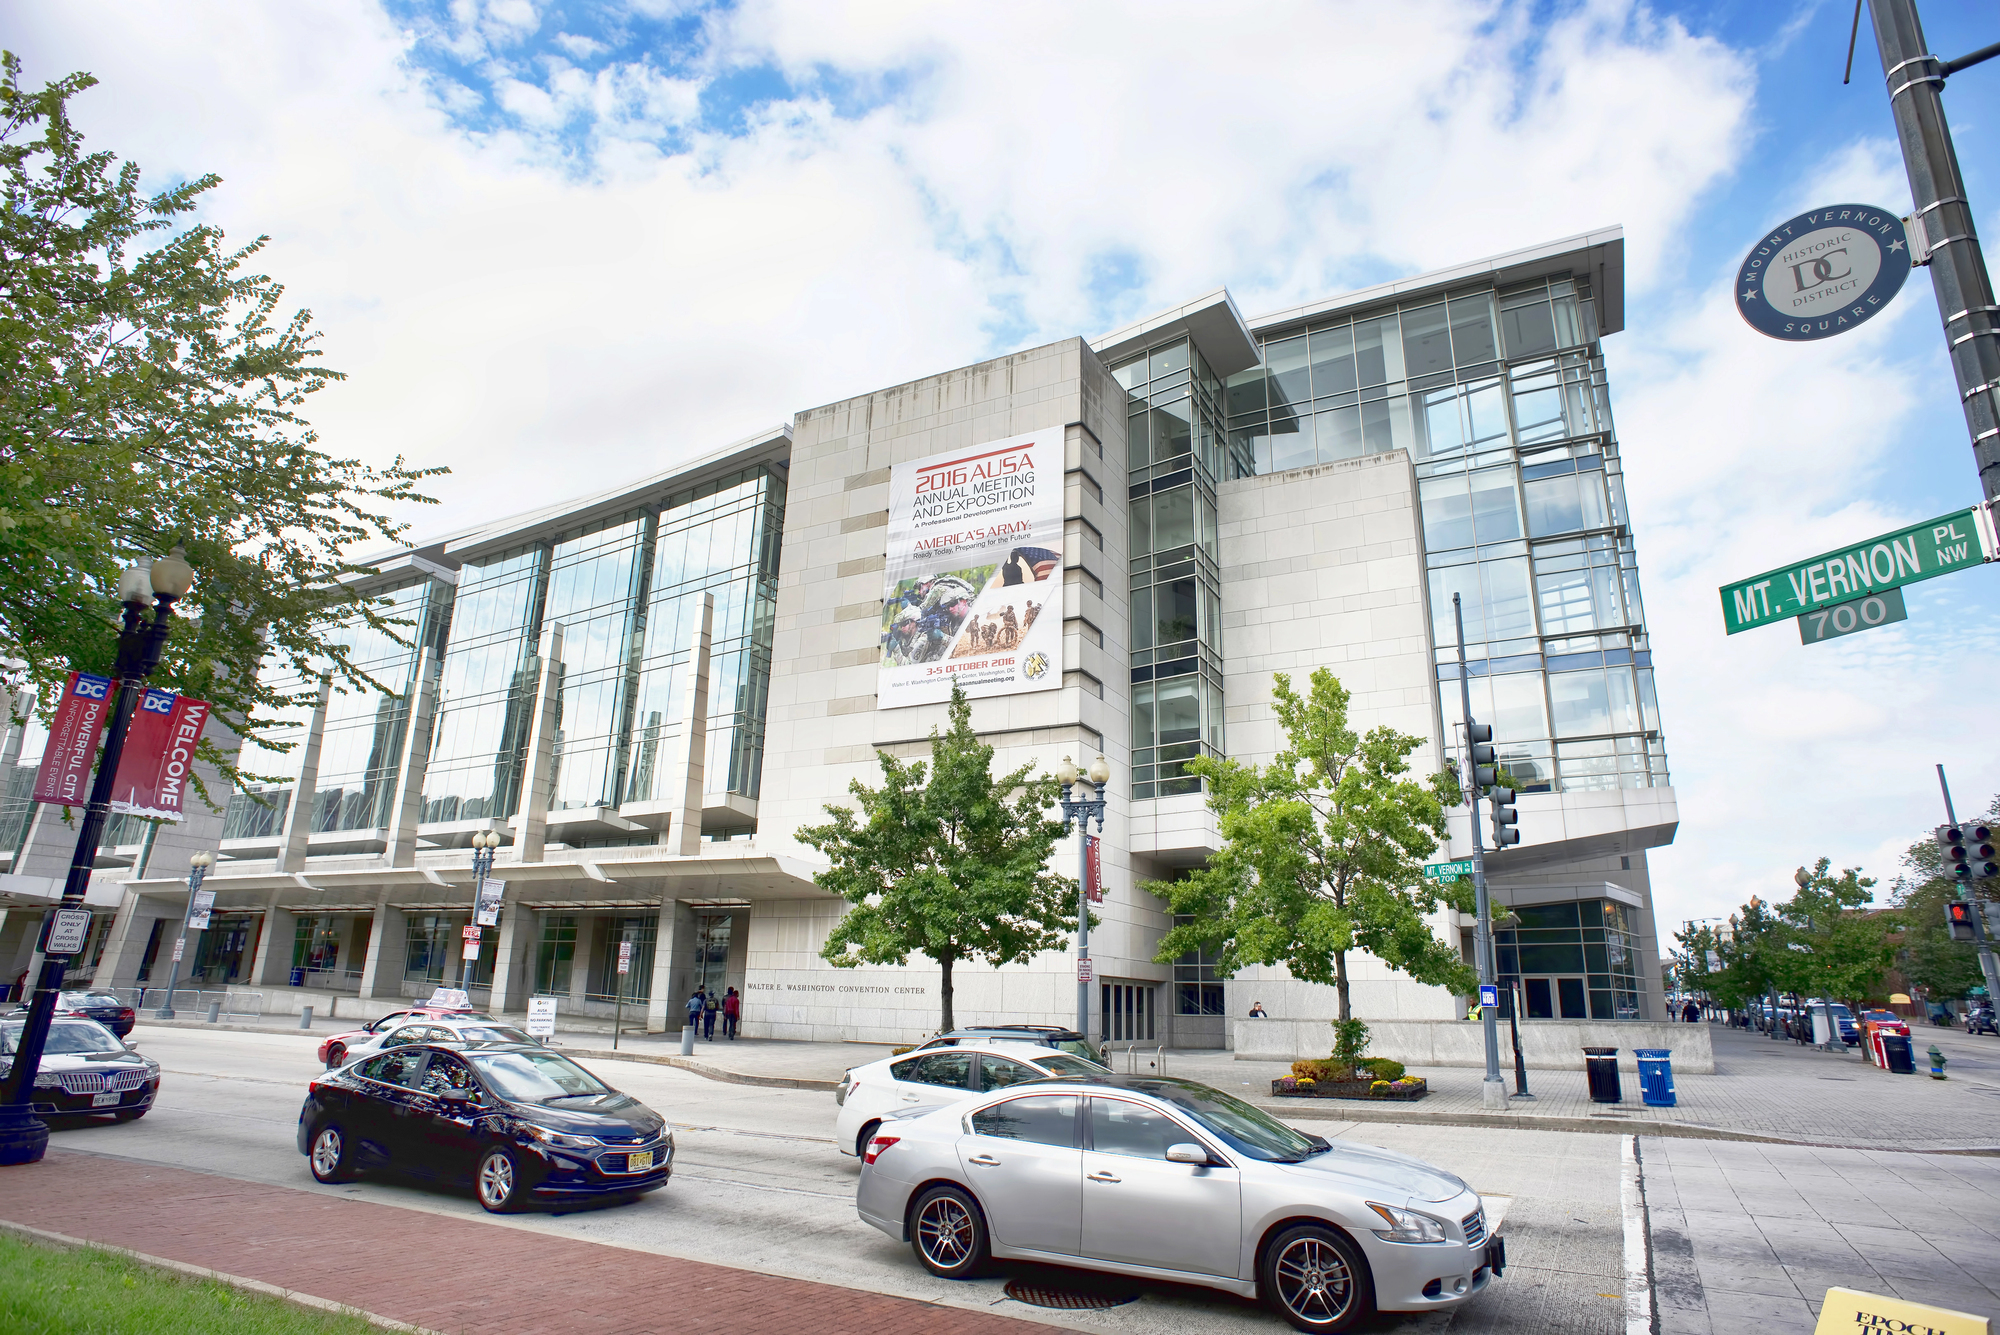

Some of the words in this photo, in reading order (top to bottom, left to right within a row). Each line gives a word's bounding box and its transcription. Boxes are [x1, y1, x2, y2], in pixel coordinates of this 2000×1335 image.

[1745, 226, 1792, 282] MOUNT
[1808, 210, 1893, 235] VERNON
[1783, 232, 1852, 264] HISTORIC
[1788, 247, 1852, 294] DC
[1792, 278, 1859, 307] DISTRICT
[1783, 294, 1881, 335] SQUARE
[912, 486, 969, 508] ANNUAL
[973, 471, 1035, 495] MEETING
[916, 466, 967, 494] 2016
[970, 453, 1035, 482] AUSA
[912, 504, 943, 521] AND
[946, 484, 1035, 514] EXPOSITION
[920, 514, 962, 527] Professional
[963, 505, 1008, 520] Development
[1009, 500, 1033, 510] Forum
[912, 549, 933, 560] Ready
[934, 546, 954, 557] Today,
[955, 540, 986, 552] Preparing
[987, 537, 997, 546] for
[997, 535, 1009, 544] the
[1010, 532, 1031, 542] Future
[913, 527, 985, 552] AMERICA'S
[986, 519, 1032, 537] ARMY:
[1936, 541, 1968, 567] NW
[1733, 580, 1782, 625] MT.
[1788, 535, 1921, 607] VERNON
[1932, 523, 1966, 545] PL
[1808, 597, 1888, 639] 700
[911, 677, 937, 686] Washington
[926, 667, 943, 676] 3-5
[945, 661, 989, 674] OCTOBER
[991, 656, 1016, 668] 2016
[51, 699, 80, 767] UNFORGETTABLE
[68, 703, 100, 771] POWERFUL
[160, 705, 206, 807] WELCOME
[44, 767, 59, 797] EVENTS
[62, 775, 78, 801] CITY
[1094, 839, 1102, 900] WELCOME
[1426, 865, 1437, 876] MT.
[1438, 863, 1463, 875] VERNON
[747, 983, 775, 991] WALTER
[776, 983, 783, 991] E.
[787, 984, 835, 992] WASHINGTON
[838, 985, 890, 994] CONVENTION
[894, 986, 926, 995] CENTER
[1853, 1310, 1947, 1335] EPOCH
